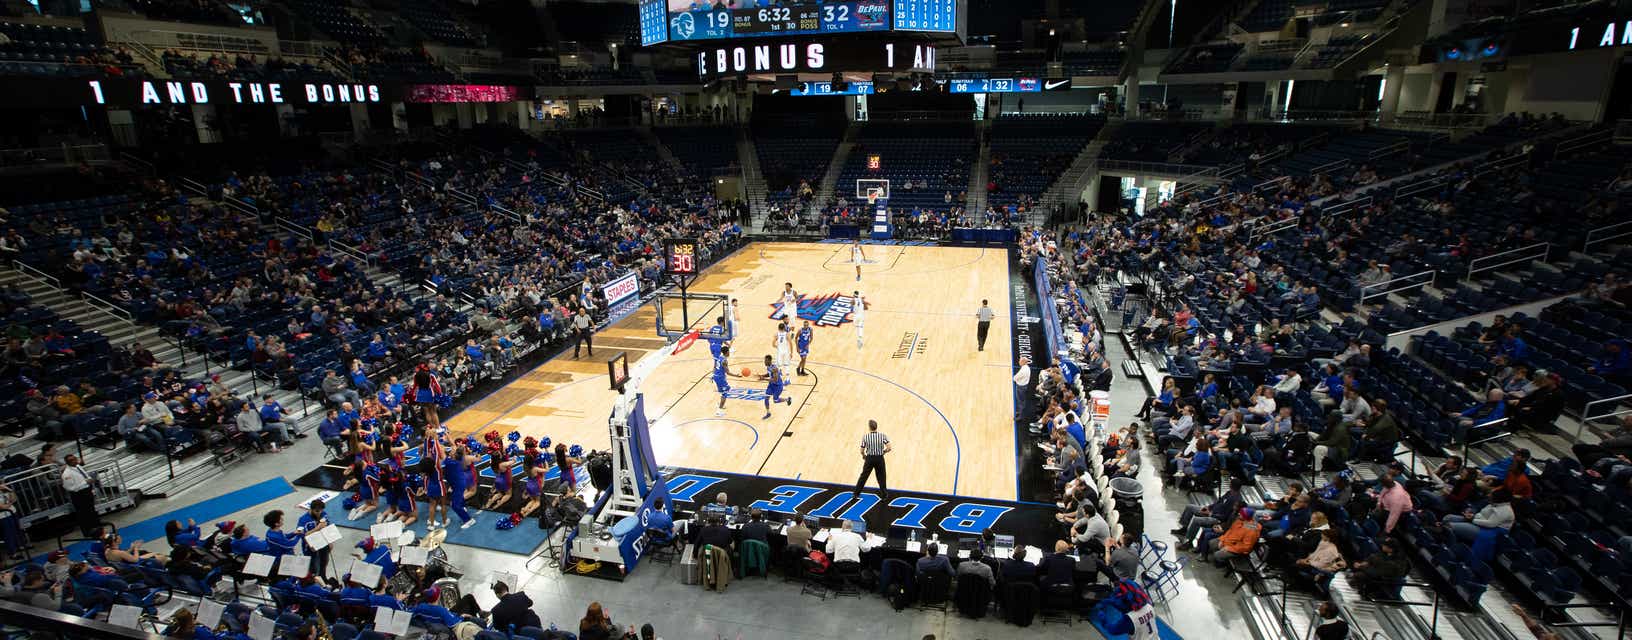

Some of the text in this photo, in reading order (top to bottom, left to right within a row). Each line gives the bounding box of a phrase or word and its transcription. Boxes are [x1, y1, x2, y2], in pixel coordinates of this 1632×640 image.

[707, 12, 729, 28] 19
[758, 8, 791, 22] 6:32
[823, 6, 849, 22] 32
[1569, 27, 1580, 49] 1
[717, 43, 824, 73] BONUS
[886, 43, 894, 68] 1
[89, 81, 105, 104] 1
[142, 81, 208, 104] AND
[229, 82, 284, 103] THE
[305, 83, 380, 103] BONUS
[820, 84, 831, 93] 19
[858, 85, 868, 94] 07
[957, 84, 967, 92] 06
[982, 83, 988, 91] 4
[995, 81, 1008, 90] 32
[674, 255, 692, 271] 30
[607, 279, 635, 301] STAPLES
[749, 485, 1015, 535] BLUE
[1146, 622, 1154, 634] 1
